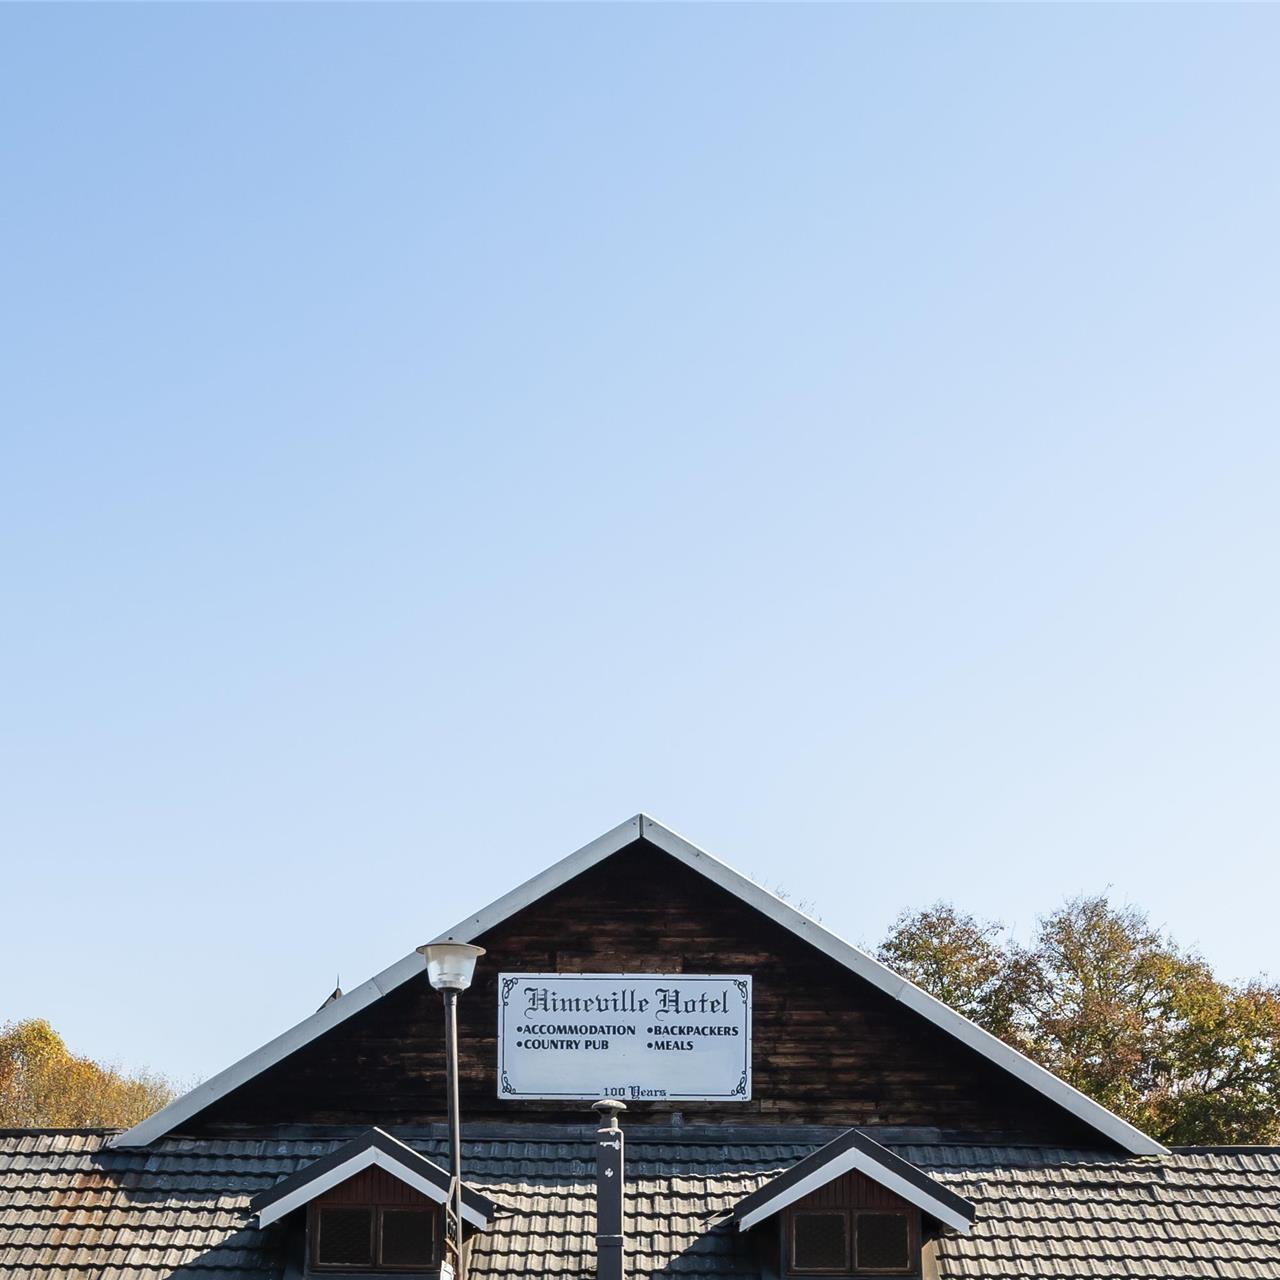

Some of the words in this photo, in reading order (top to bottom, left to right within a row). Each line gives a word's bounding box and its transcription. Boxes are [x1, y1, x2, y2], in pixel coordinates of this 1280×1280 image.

[524, 987, 650, 1019] Himeville
[655, 988, 729, 1021] Hotel
[523, 1024, 636, 1035] ACCOMMODATION
[654, 1025, 738, 1036] BACKPACKERS
[524, 1039, 580, 1050] COUNTRY
[585, 1039, 608, 1050] PUB
[654, 1040, 694, 1051] MEALS
[604, 1087, 625, 1096] 100
[628, 1085, 667, 1099] Years
